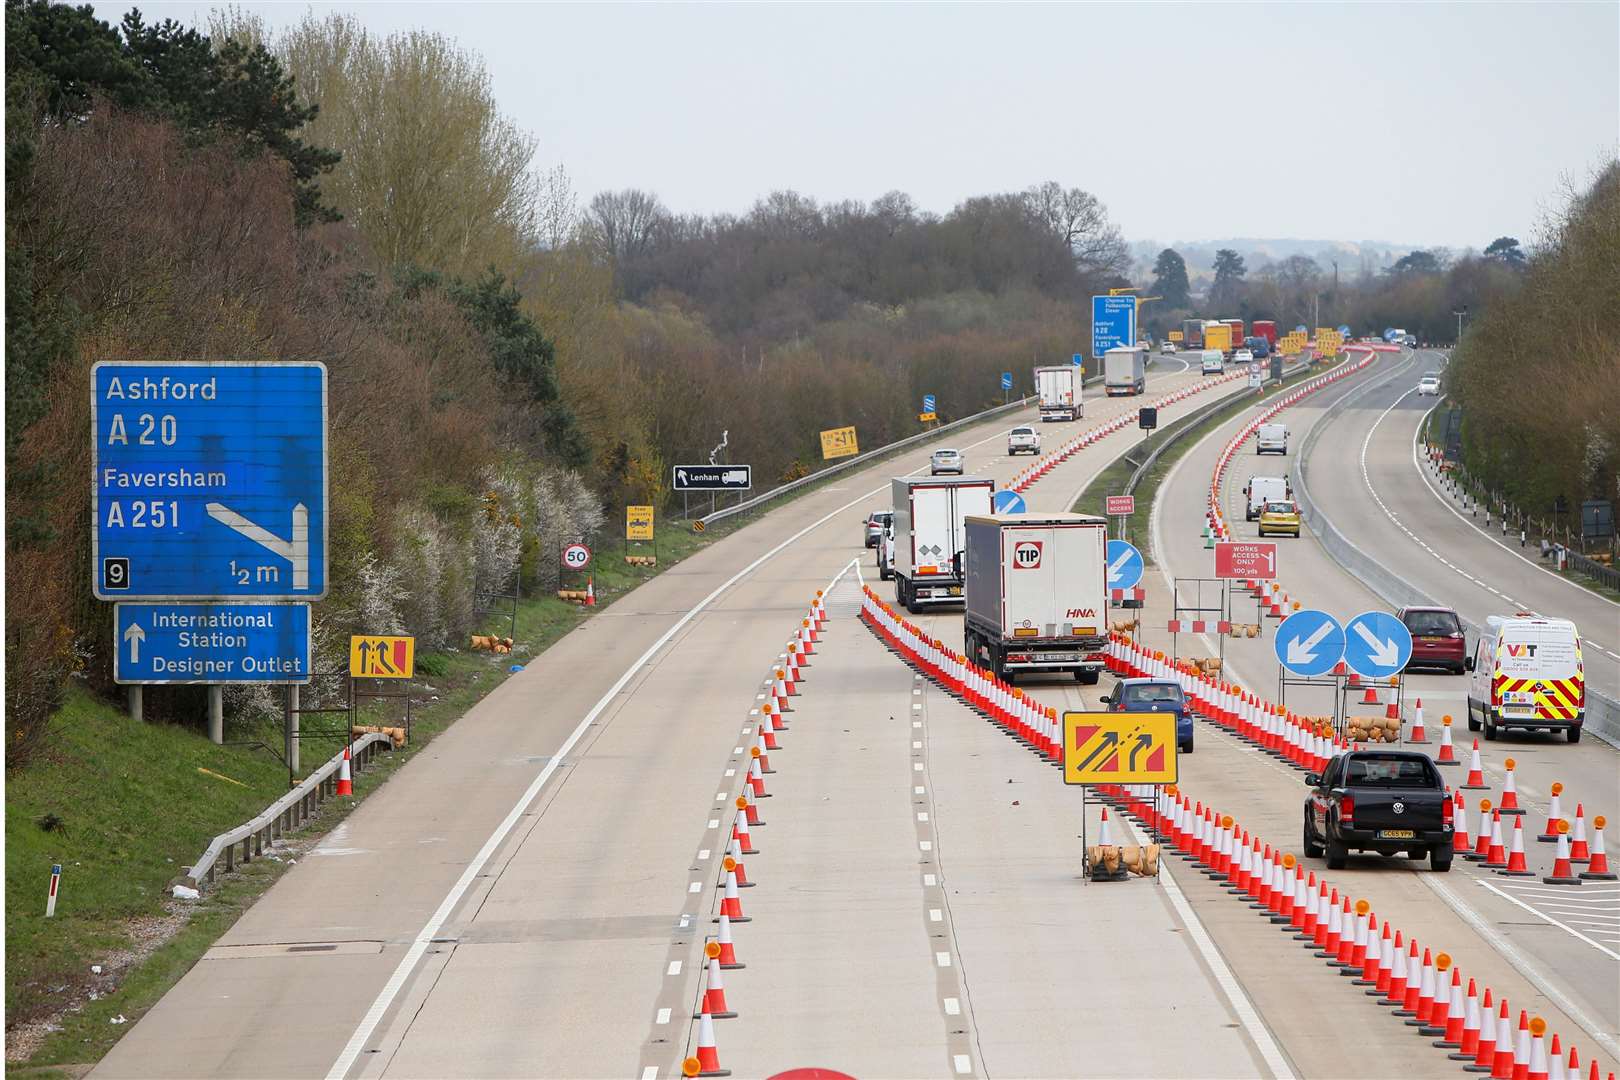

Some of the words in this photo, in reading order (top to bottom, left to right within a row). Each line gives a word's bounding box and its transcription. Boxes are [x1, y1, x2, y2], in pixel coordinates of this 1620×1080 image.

[106, 376, 217, 401] Ashford
[103, 468, 227, 488] Faversham
[690, 473, 720, 481] Lenham
[567, 551, 586, 562] 50
[1017, 549, 1039, 562] TIP
[1233, 545, 1259, 553] WORKS
[109, 563, 125, 584] 9
[256, 565, 279, 583] m
[152, 612, 274, 628] International
[178, 632, 247, 648] Station
[152, 657, 234, 676] Designer
[241, 657, 302, 673] Outlet
